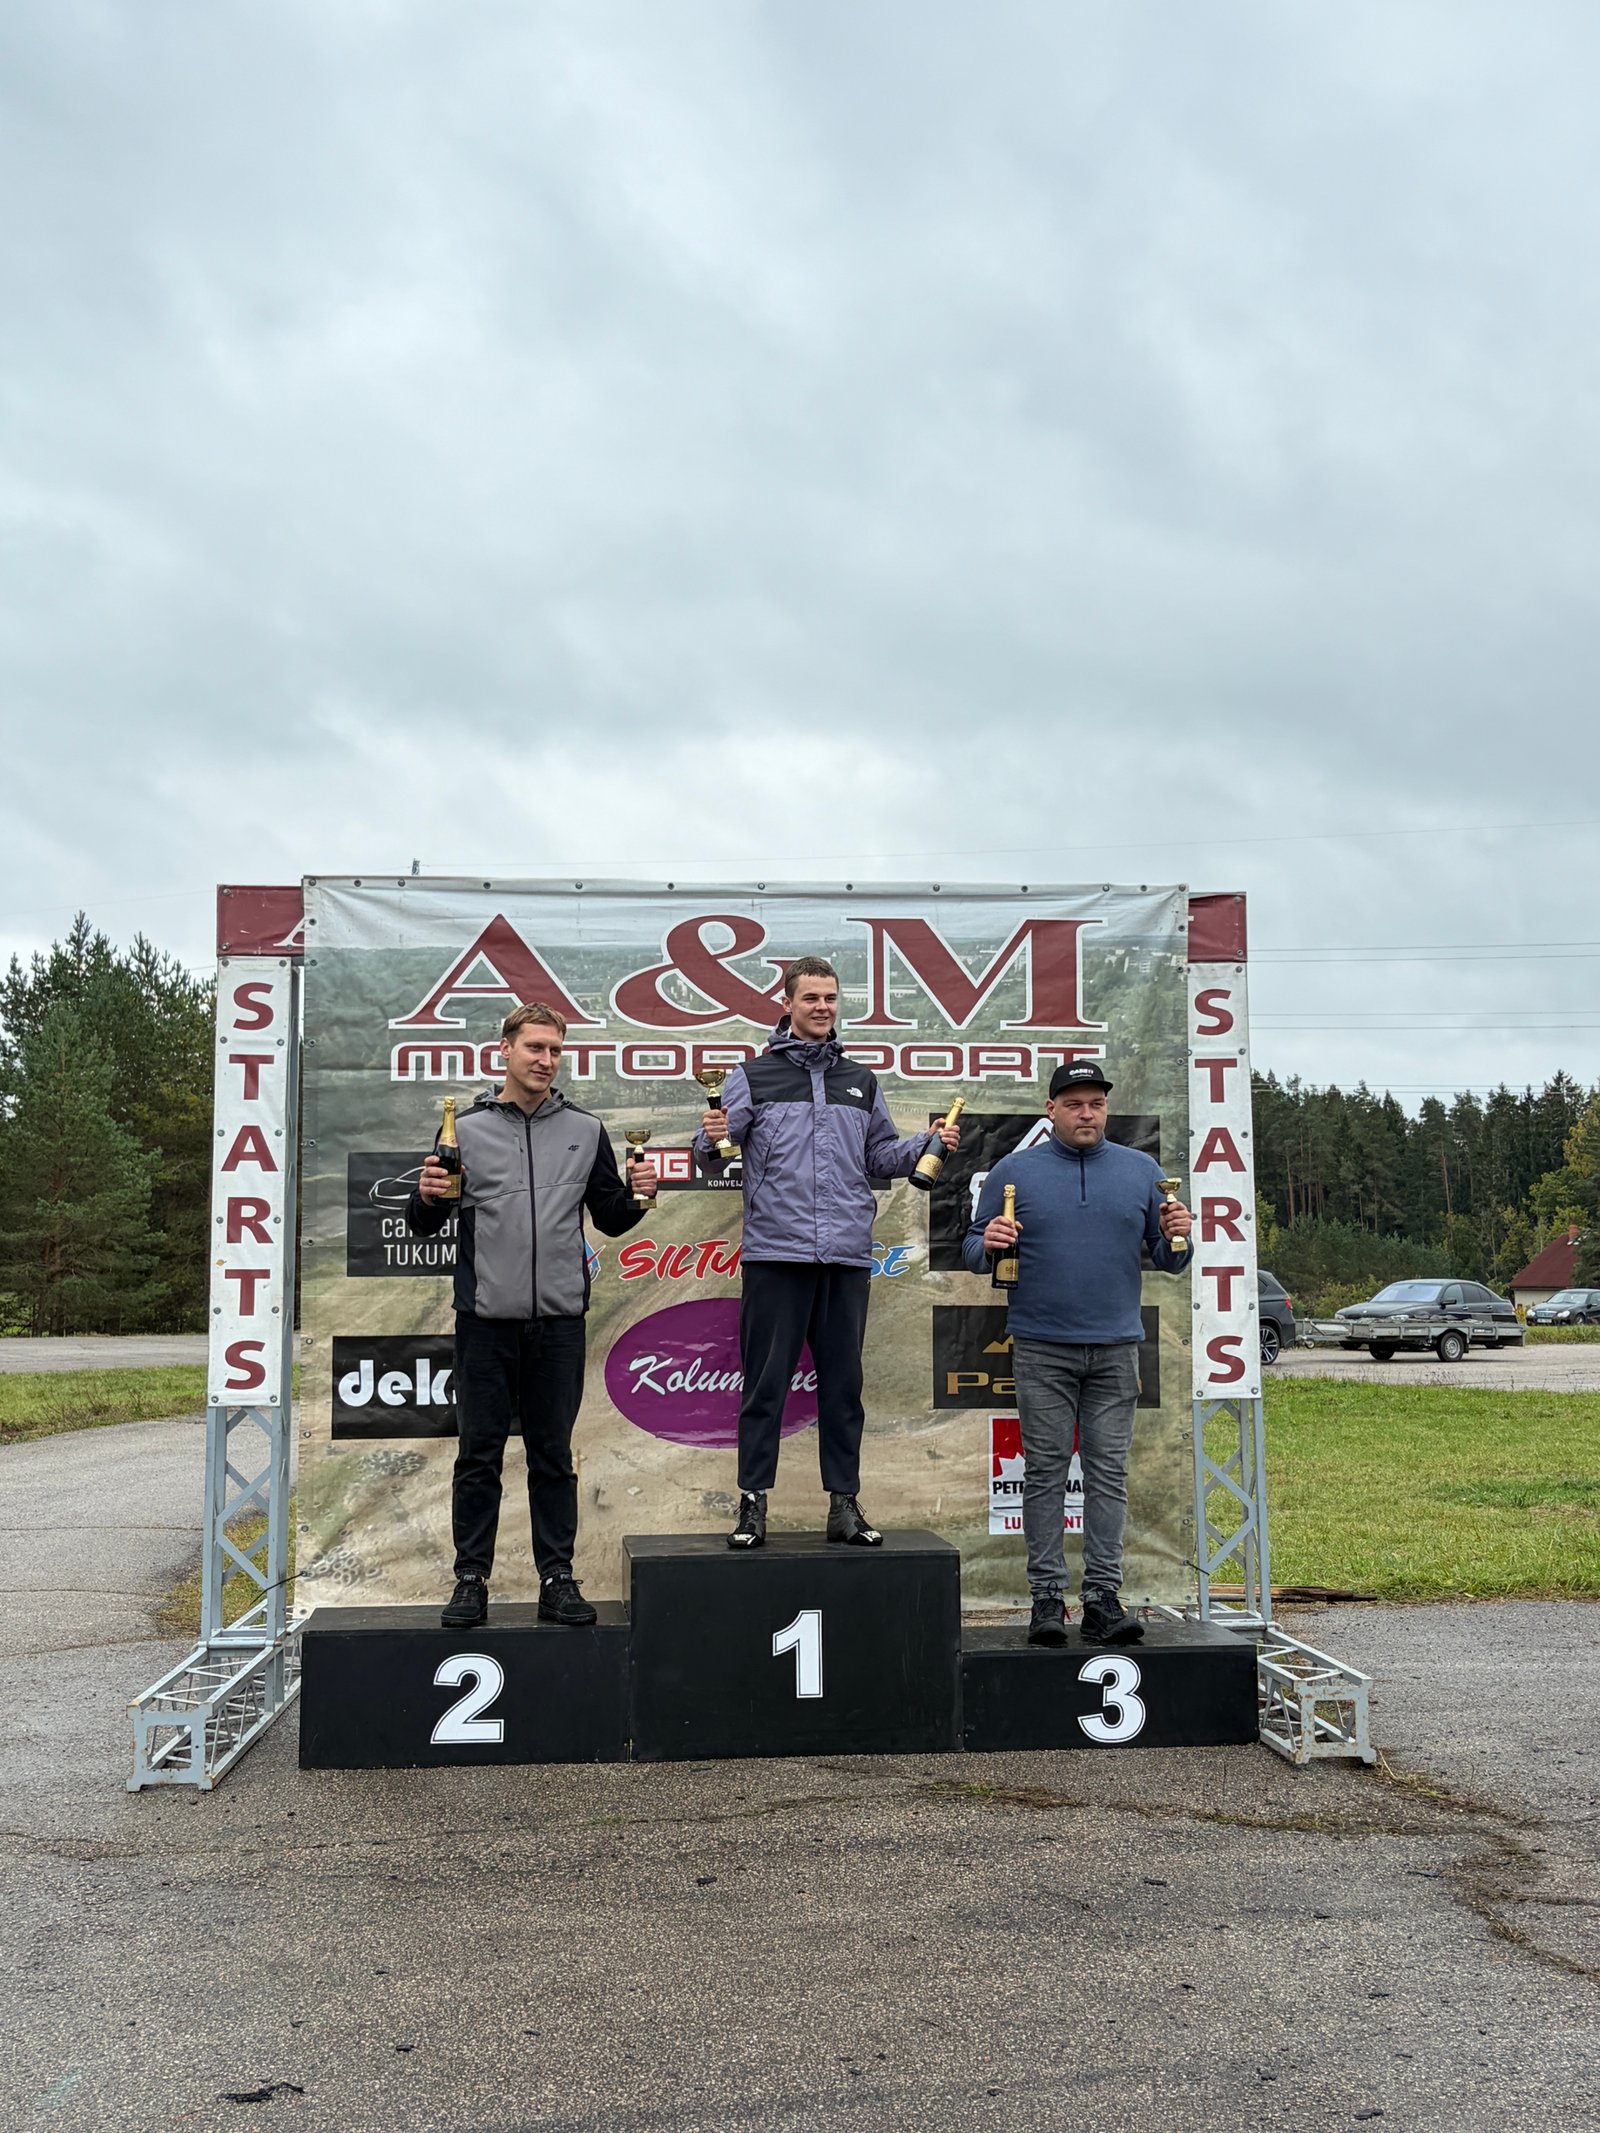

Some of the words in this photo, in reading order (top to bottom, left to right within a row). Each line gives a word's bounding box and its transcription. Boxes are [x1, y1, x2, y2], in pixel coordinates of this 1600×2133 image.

[388, 913, 606, 1029] A
[609, 914, 786, 1030] &
[841, 917, 1109, 1032] M
[220, 981, 279, 1390] STARTS
[1192, 987, 1248, 1384] STARTS
[430, 1653, 505, 1744] 2
[773, 1609, 823, 1699] 1
[1077, 1654, 1146, 1743] 3
